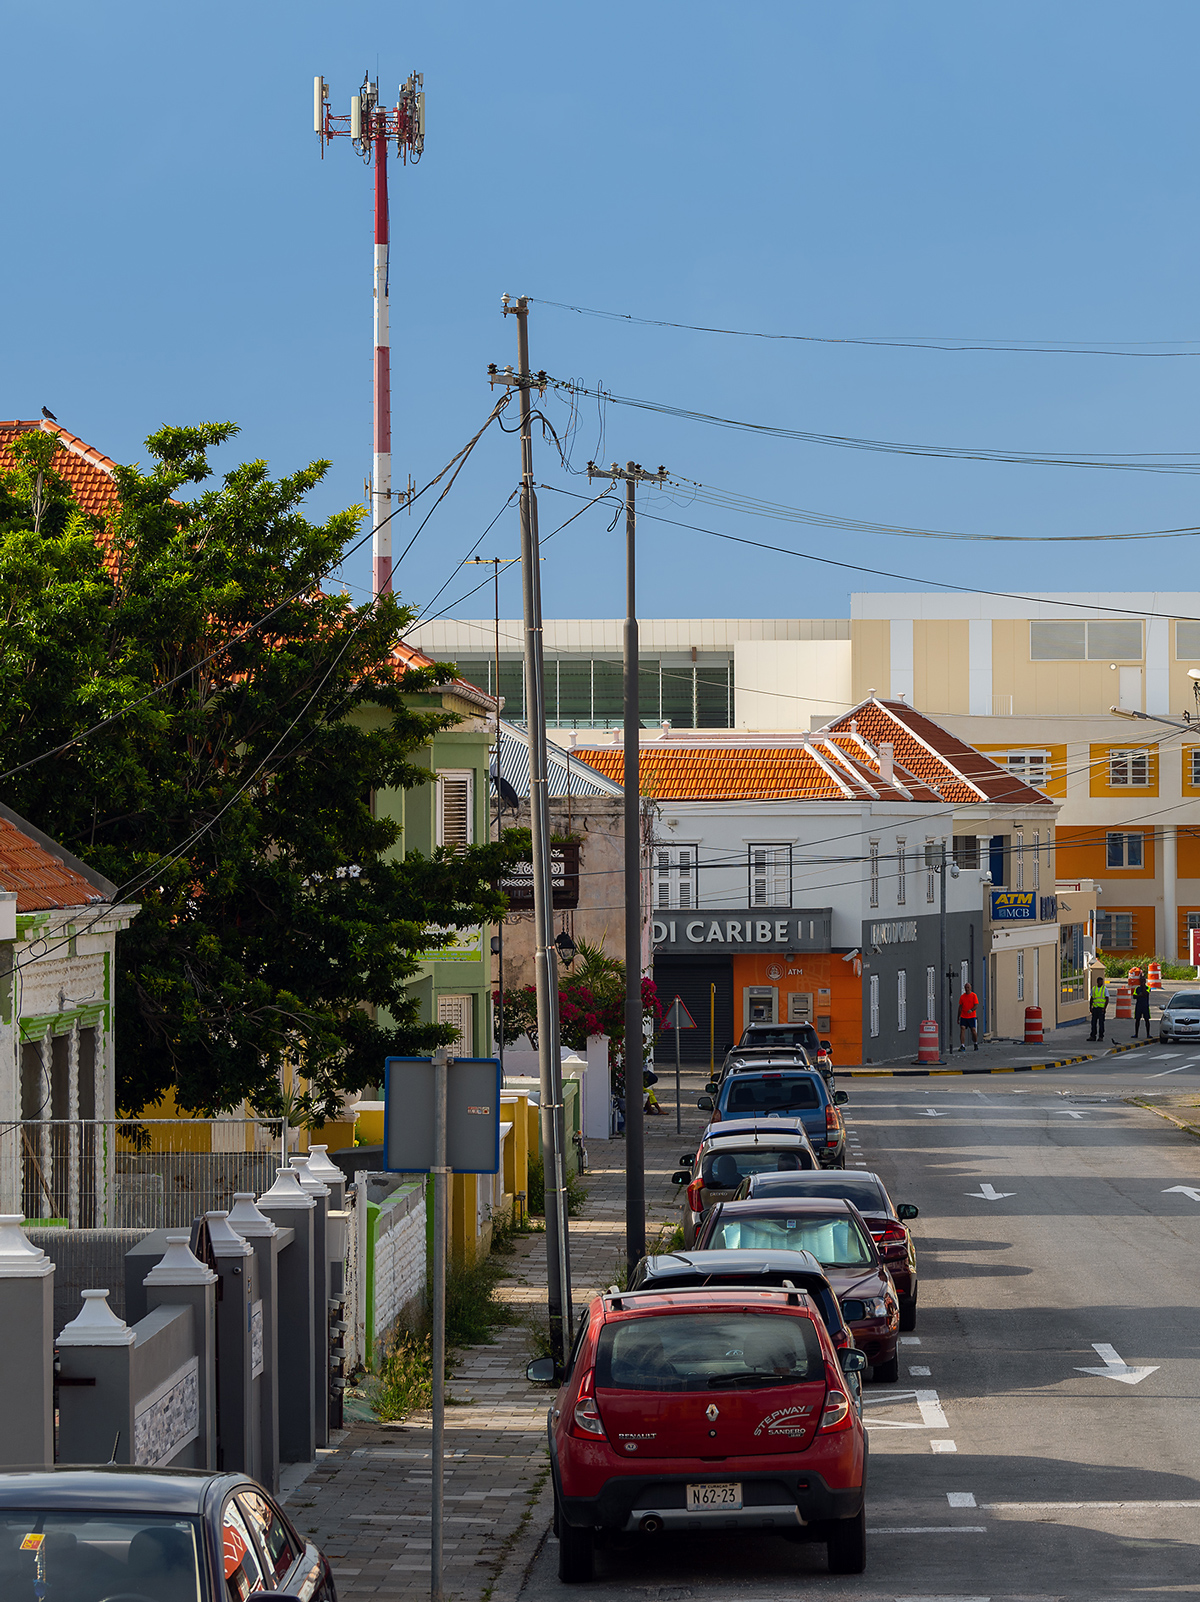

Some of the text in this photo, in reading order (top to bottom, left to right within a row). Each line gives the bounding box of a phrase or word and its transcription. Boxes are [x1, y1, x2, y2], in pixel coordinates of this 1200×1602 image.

[995, 894, 1033, 904] ATM
[1006, 909, 1030, 918] MCB
[652, 921, 789, 943] DI CARIBE
[753, 1405, 806, 1436] STEPWAY
